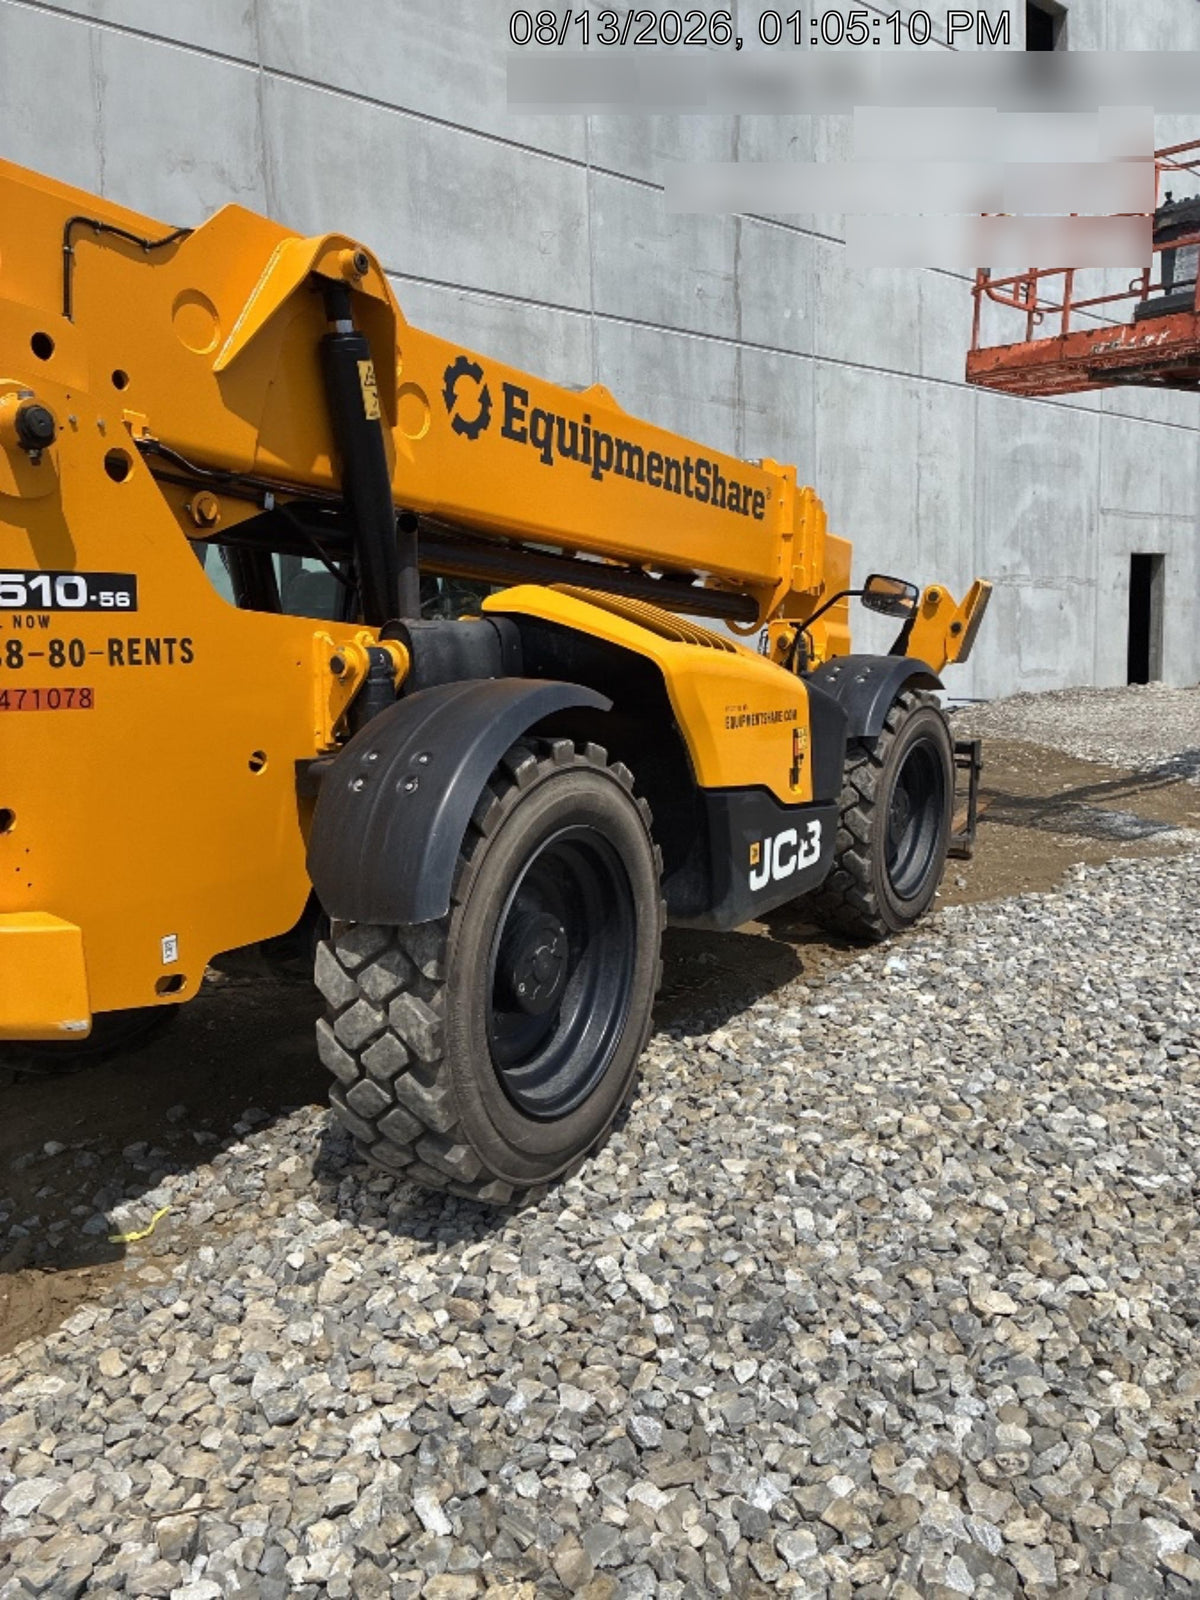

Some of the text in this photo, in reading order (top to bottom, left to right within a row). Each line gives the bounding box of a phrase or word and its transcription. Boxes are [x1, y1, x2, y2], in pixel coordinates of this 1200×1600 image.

[501, 381, 767, 520] EquipmentShare
[12, 614, 50, 629] NOW
[0, 637, 194, 669] 8-80-RENTS
[749, 818, 822, 891] JCB
